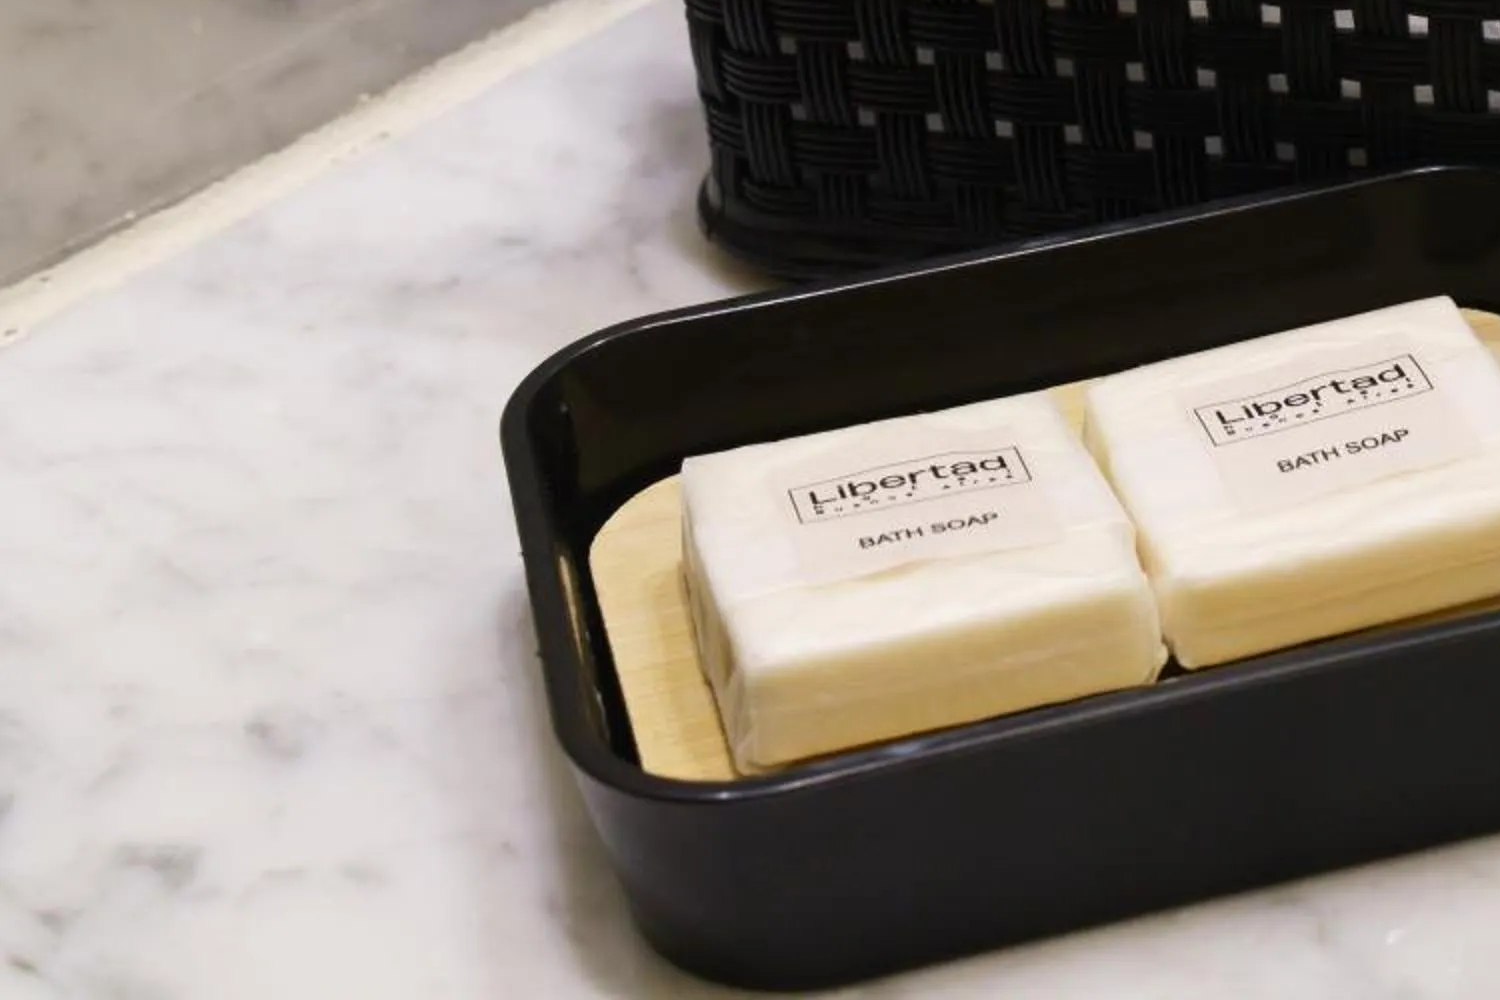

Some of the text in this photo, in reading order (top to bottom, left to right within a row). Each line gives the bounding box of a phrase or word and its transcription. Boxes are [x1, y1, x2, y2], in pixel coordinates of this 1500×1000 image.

[1215, 363, 1407, 425] Libertad
[1276, 429, 1409, 473] BATH SOAP
[809, 455, 1007, 506] Libertad
[859, 512, 998, 549] BATH SOAP
